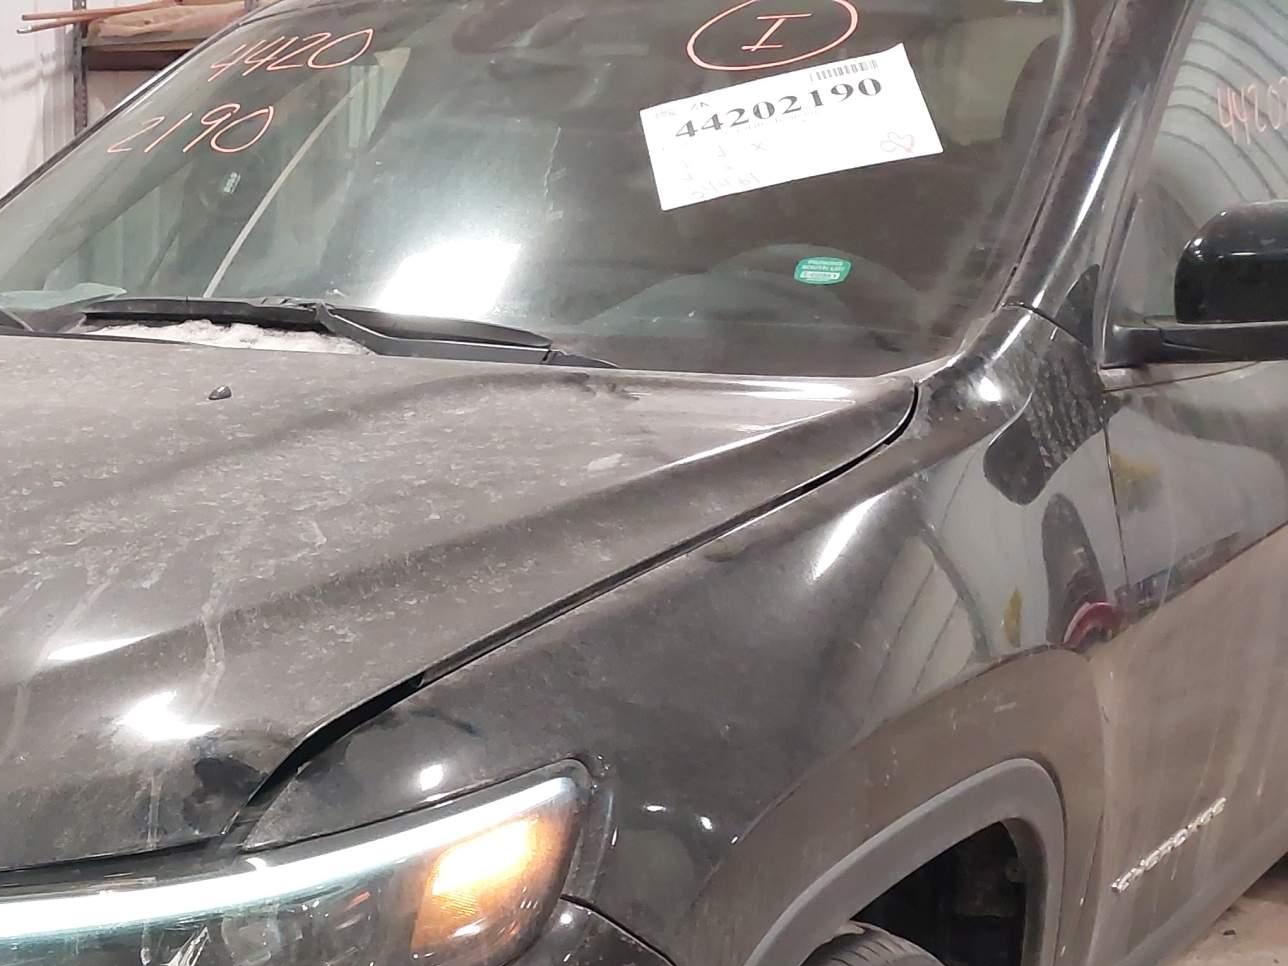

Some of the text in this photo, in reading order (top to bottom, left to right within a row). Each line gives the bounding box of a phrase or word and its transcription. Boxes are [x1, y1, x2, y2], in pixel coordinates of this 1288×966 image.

[207, 28, 374, 82] 4420
[107, 103, 275, 153] 2190
[675, 77, 882, 138] 44202190
